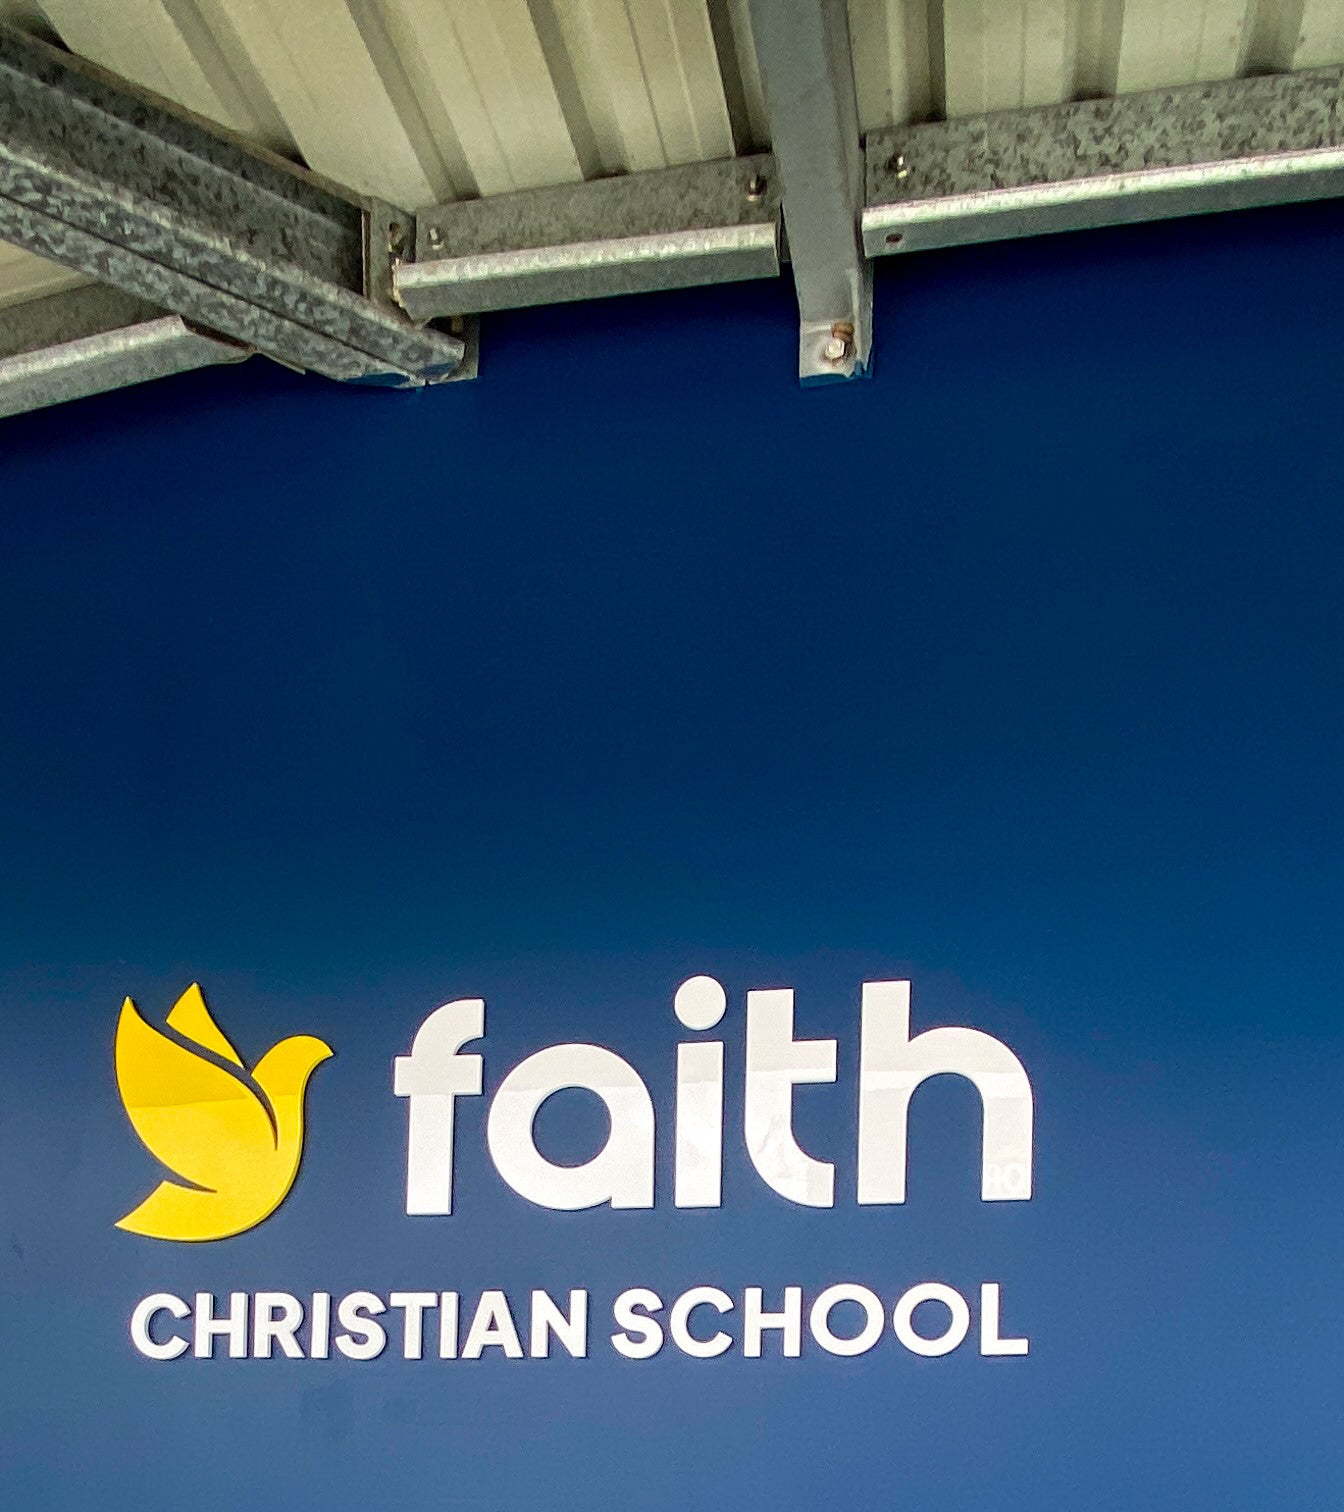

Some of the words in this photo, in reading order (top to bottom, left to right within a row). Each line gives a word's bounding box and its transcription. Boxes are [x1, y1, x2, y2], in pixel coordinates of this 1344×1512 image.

[393, 975, 1035, 1216] faith
[130, 1289, 589, 1360] CHRISTIAN
[610, 1282, 1030, 1359] SCHOOL
